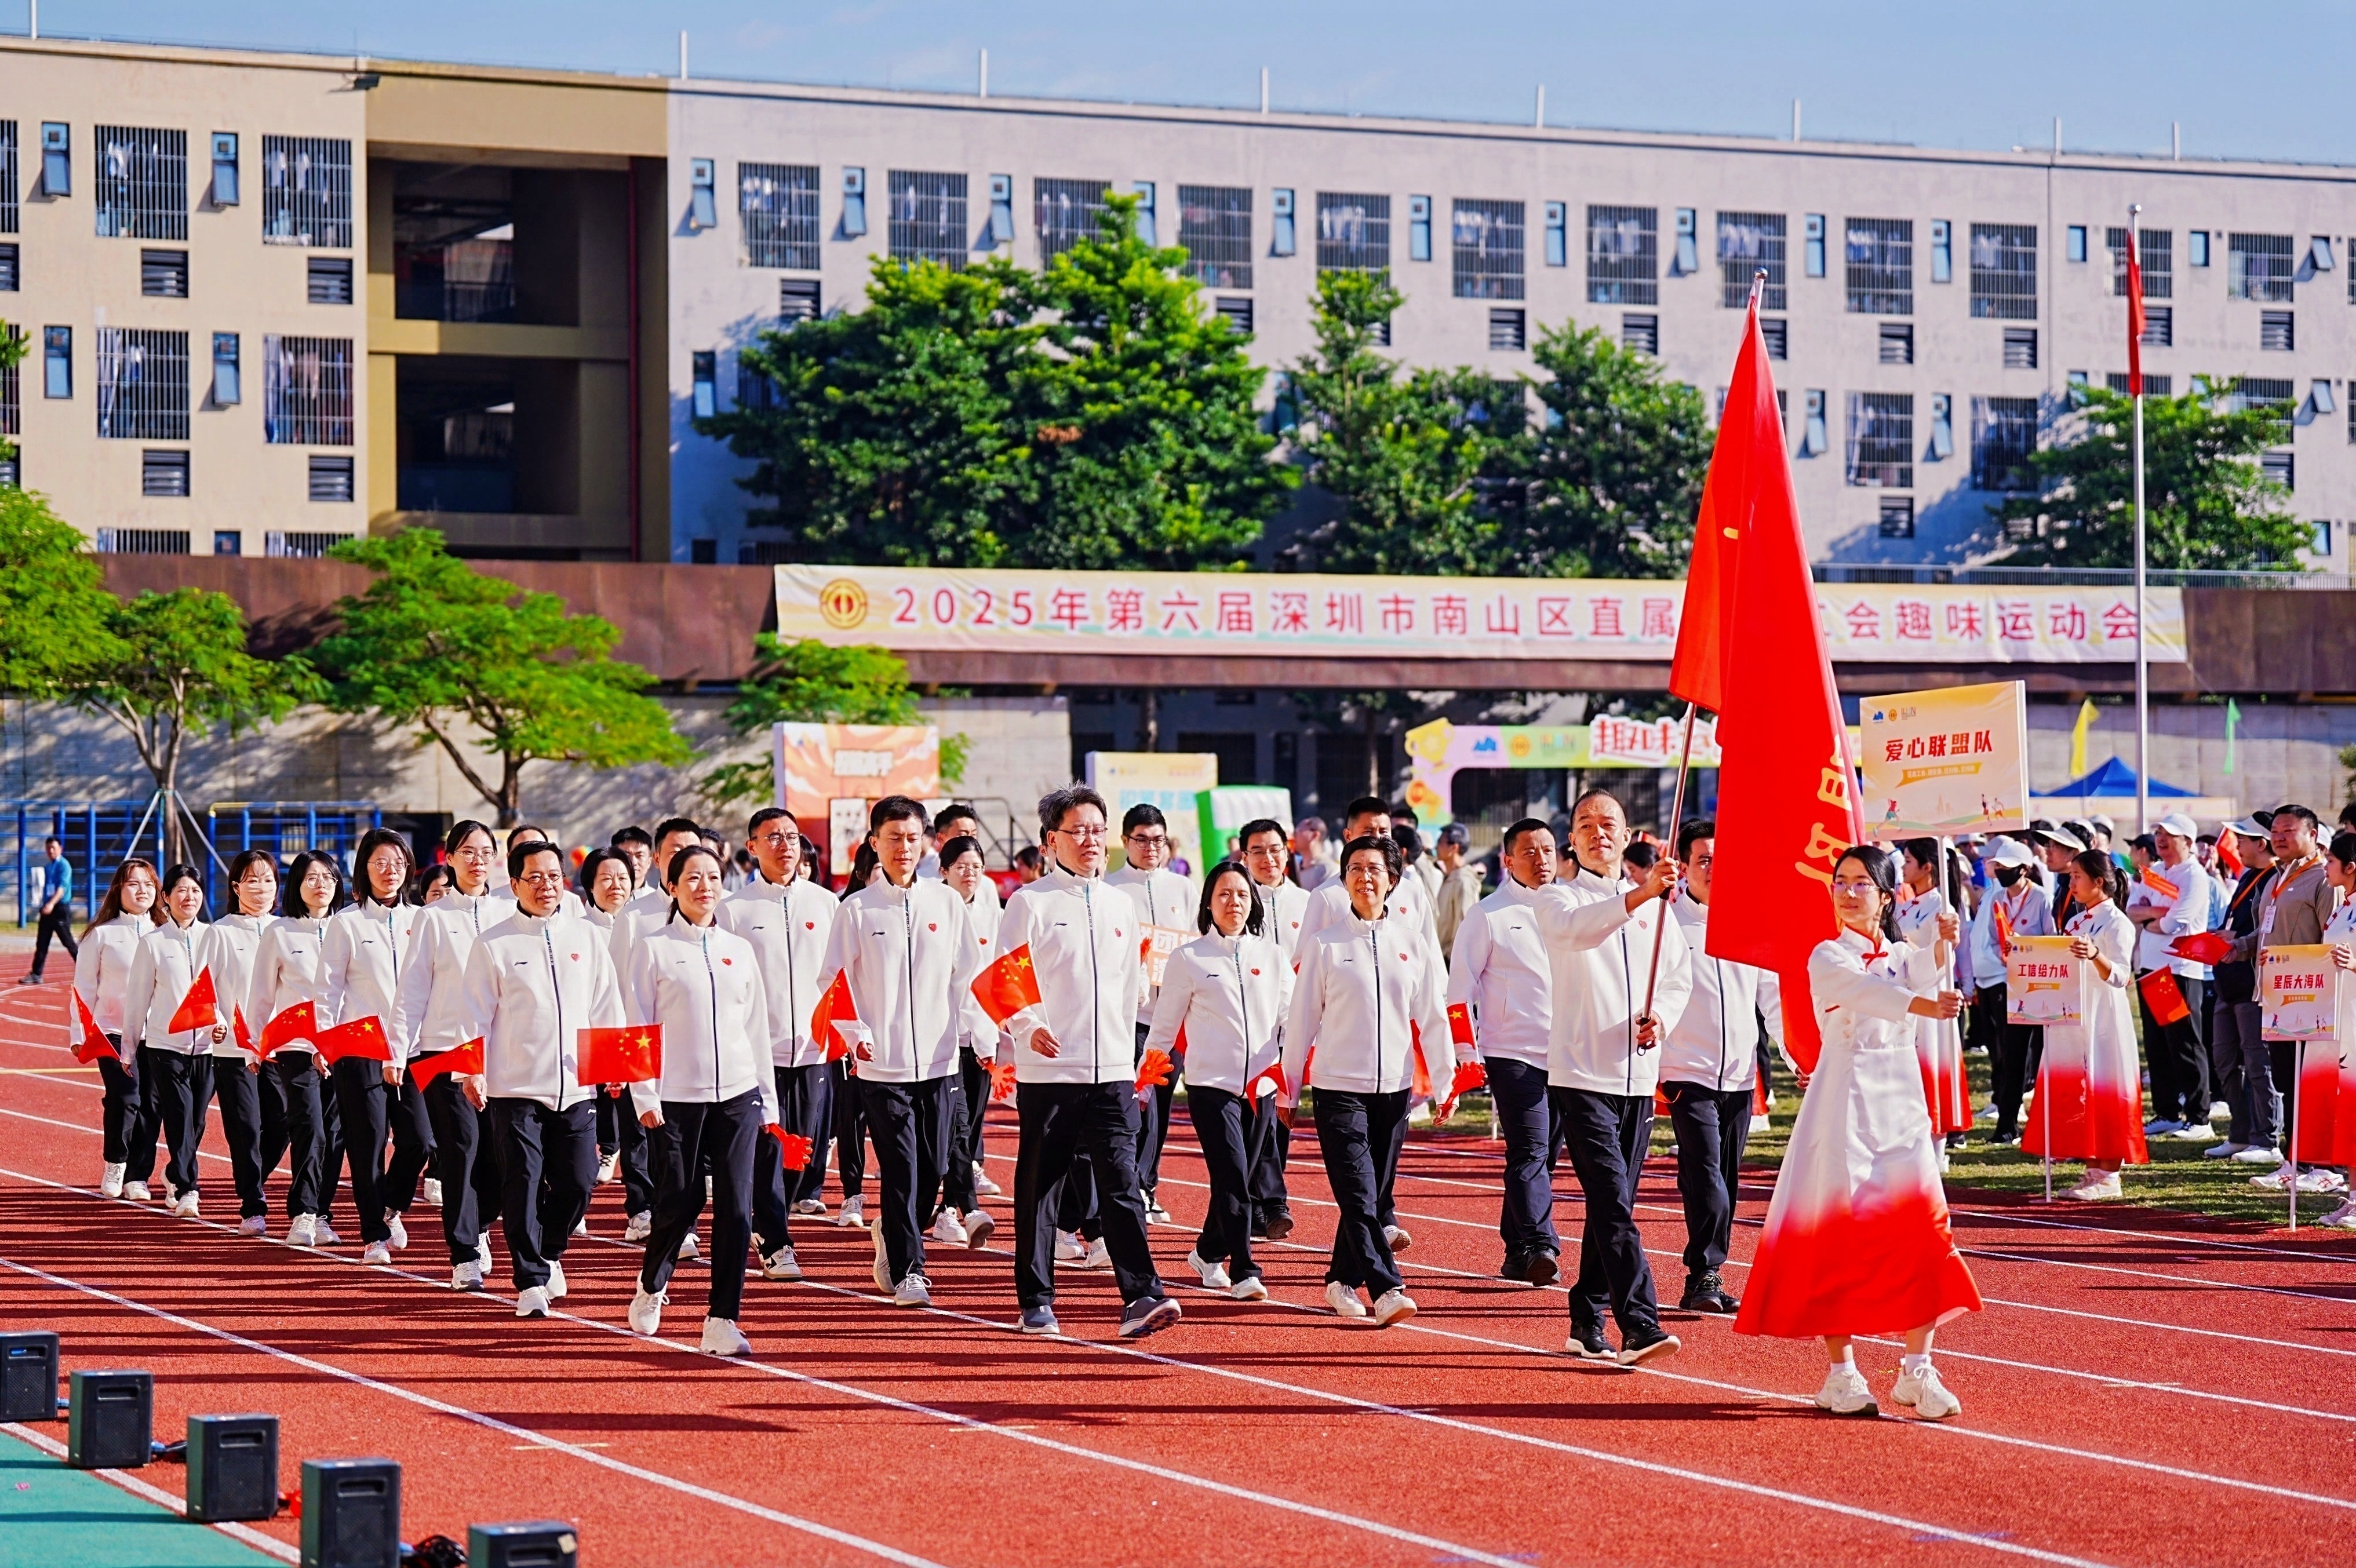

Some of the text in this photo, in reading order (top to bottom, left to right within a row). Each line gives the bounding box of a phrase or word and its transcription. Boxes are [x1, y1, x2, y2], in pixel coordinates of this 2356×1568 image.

[894, 587, 2137, 640] 2025年第六届深圳市南山区直属会趣味运动会
[1885, 730, 1992, 761] 爱心联盟队
[2018, 964, 2068, 978] 工信给力队
[2274, 974, 2324, 989] 星辰大海队
